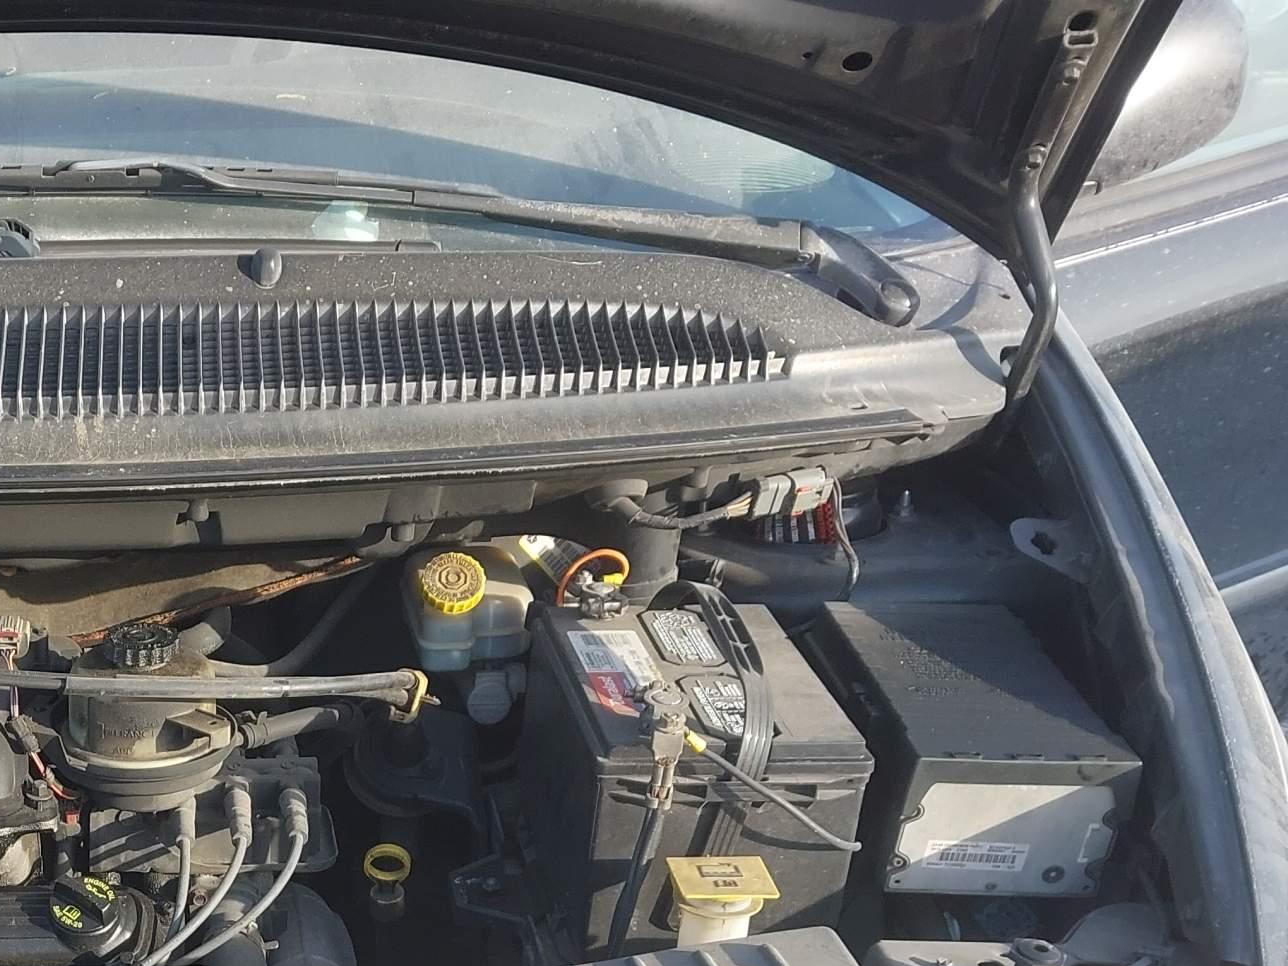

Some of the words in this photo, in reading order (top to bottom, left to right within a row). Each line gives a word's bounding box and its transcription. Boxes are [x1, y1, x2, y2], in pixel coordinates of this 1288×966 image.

[84, 877, 110, 891] ENGINE
[107, 890, 116, 901] OIL
[52, 905, 64, 918] SAE
[60, 916, 83, 928] 5W-20
